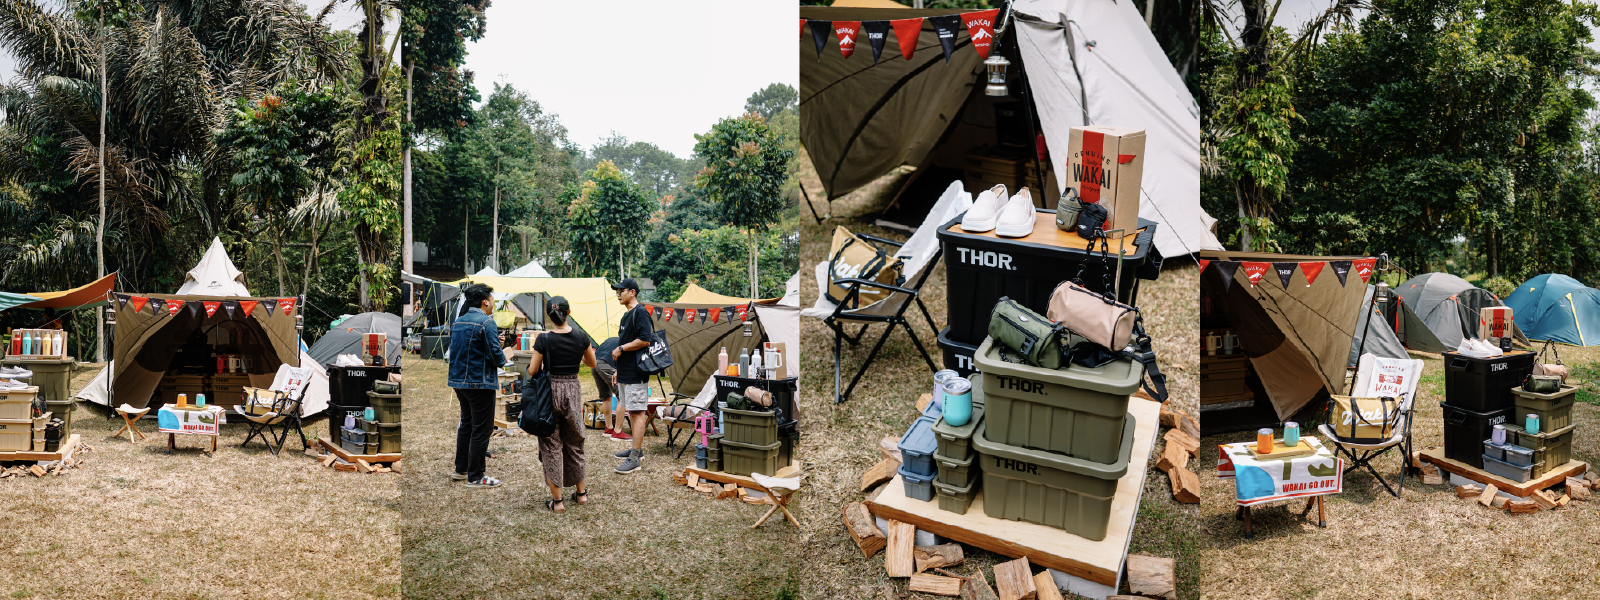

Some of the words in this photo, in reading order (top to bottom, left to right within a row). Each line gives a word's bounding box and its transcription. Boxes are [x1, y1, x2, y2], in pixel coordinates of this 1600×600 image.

[967, 19, 991, 29] WAKAI
[836, 27, 855, 35] WAKAI
[869, 32, 884, 40] THOR
[1073, 163, 1111, 190] WAKAI
[1488, 322, 1509, 332] WAKAI
[1282, 483, 1307, 493] WAKAI
[1308, 481, 1319, 490] GO
